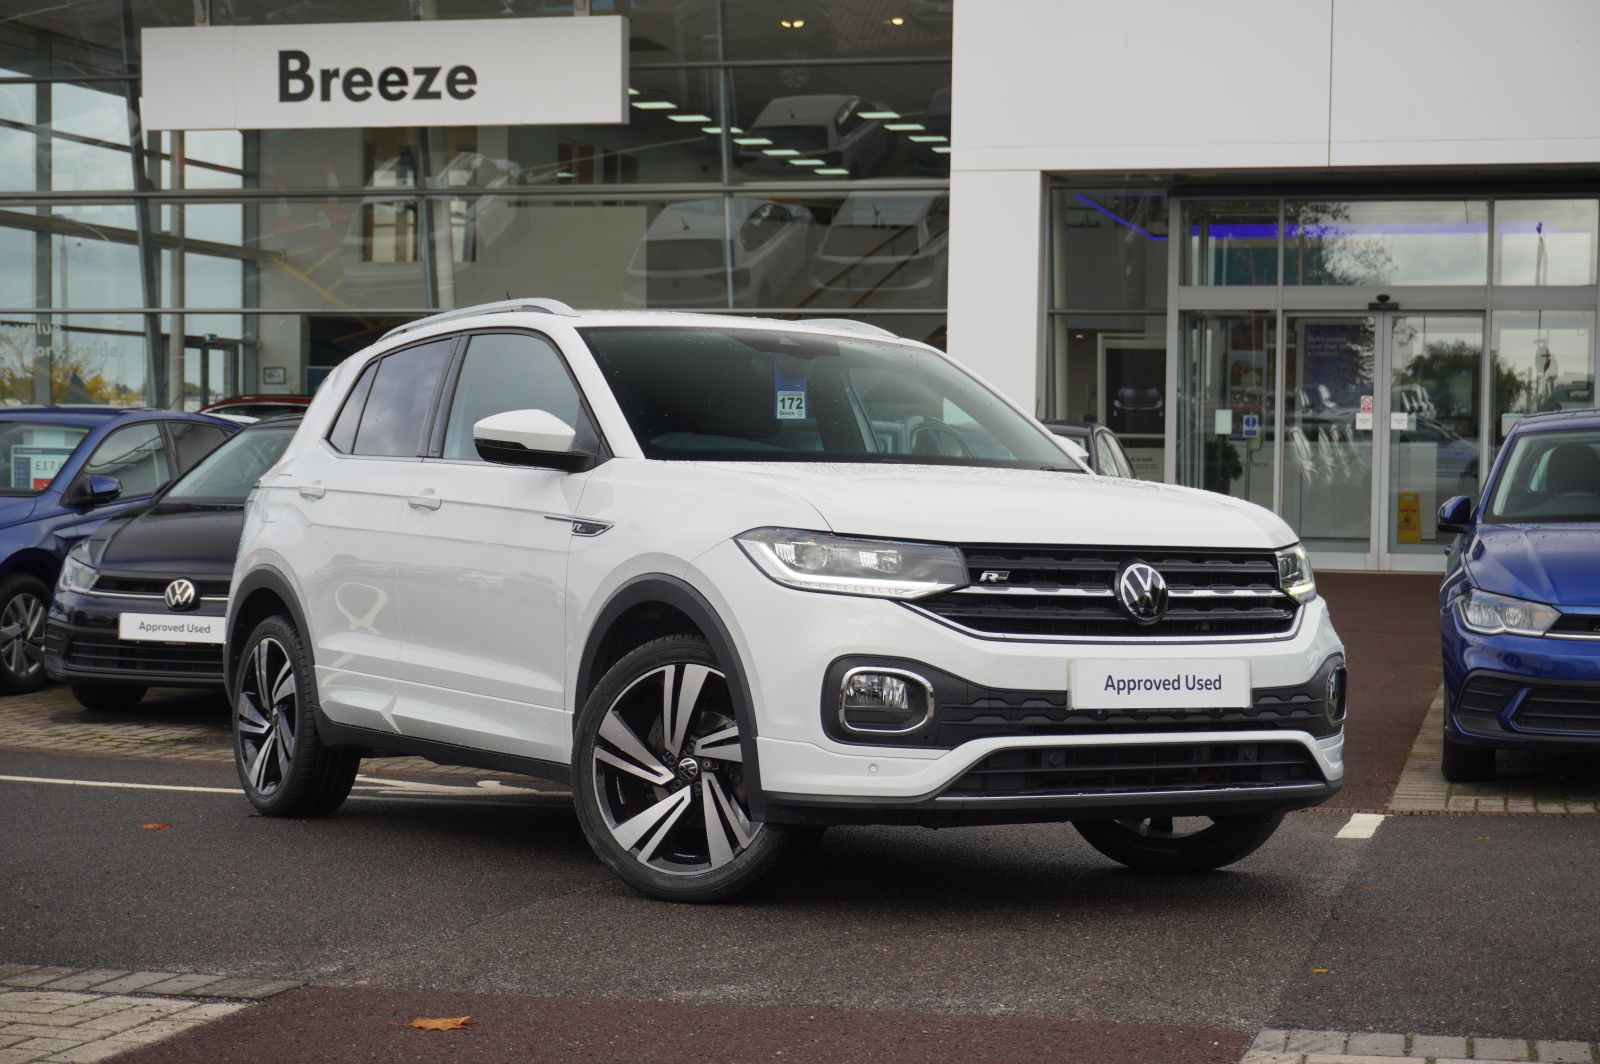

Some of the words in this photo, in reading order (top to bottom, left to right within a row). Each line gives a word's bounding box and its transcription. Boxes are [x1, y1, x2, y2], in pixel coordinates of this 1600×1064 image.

[277, 49, 478, 103] Breeze
[779, 397, 804, 410] 172
[138, 621, 185, 633] Approved
[187, 624, 211, 634] Used
[1104, 674, 1181, 695] Approved
[1185, 674, 1222, 691] Used
